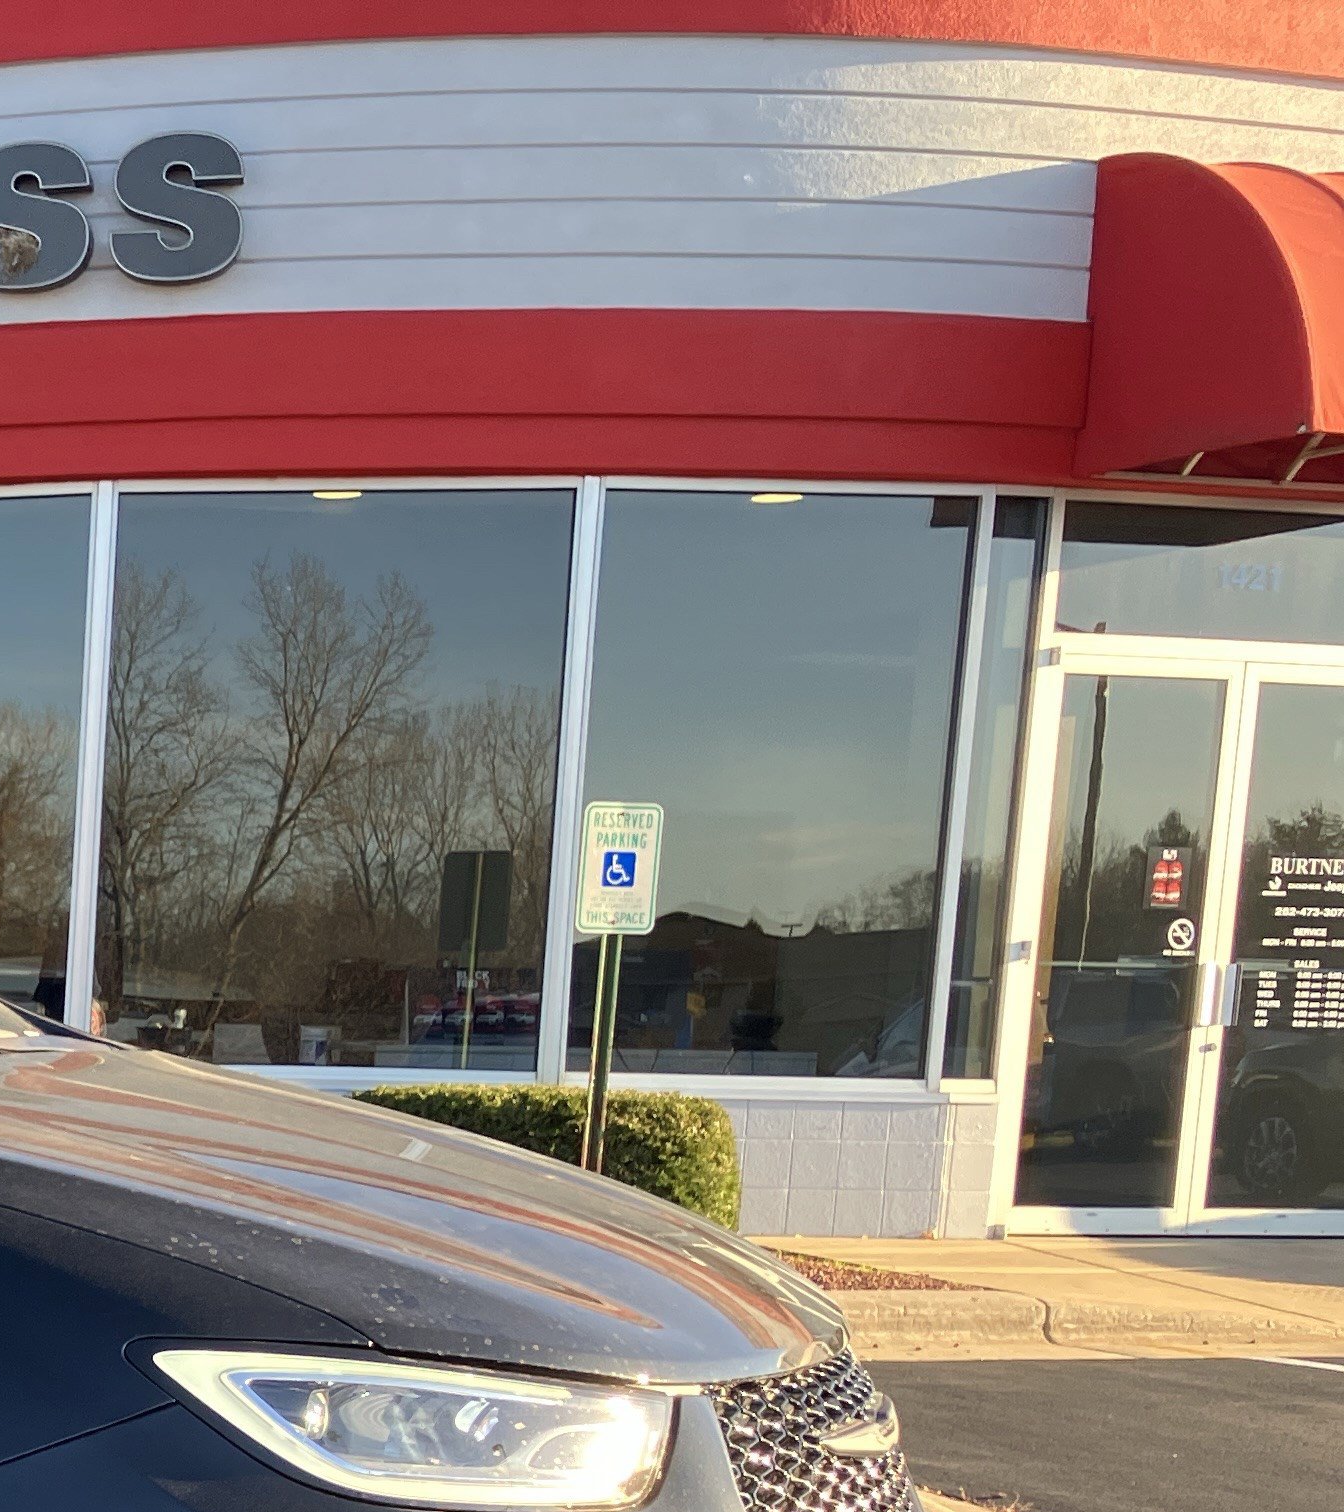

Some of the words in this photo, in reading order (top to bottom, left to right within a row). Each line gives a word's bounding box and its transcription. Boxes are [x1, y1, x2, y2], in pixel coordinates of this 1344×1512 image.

[593, 811, 654, 829] RESERVED
[596, 832, 648, 849] PARKING
[586, 911, 609, 924] THIS
[613, 911, 646, 925] SPACE
[1274, 906, 1344, 918] 262-473-307
